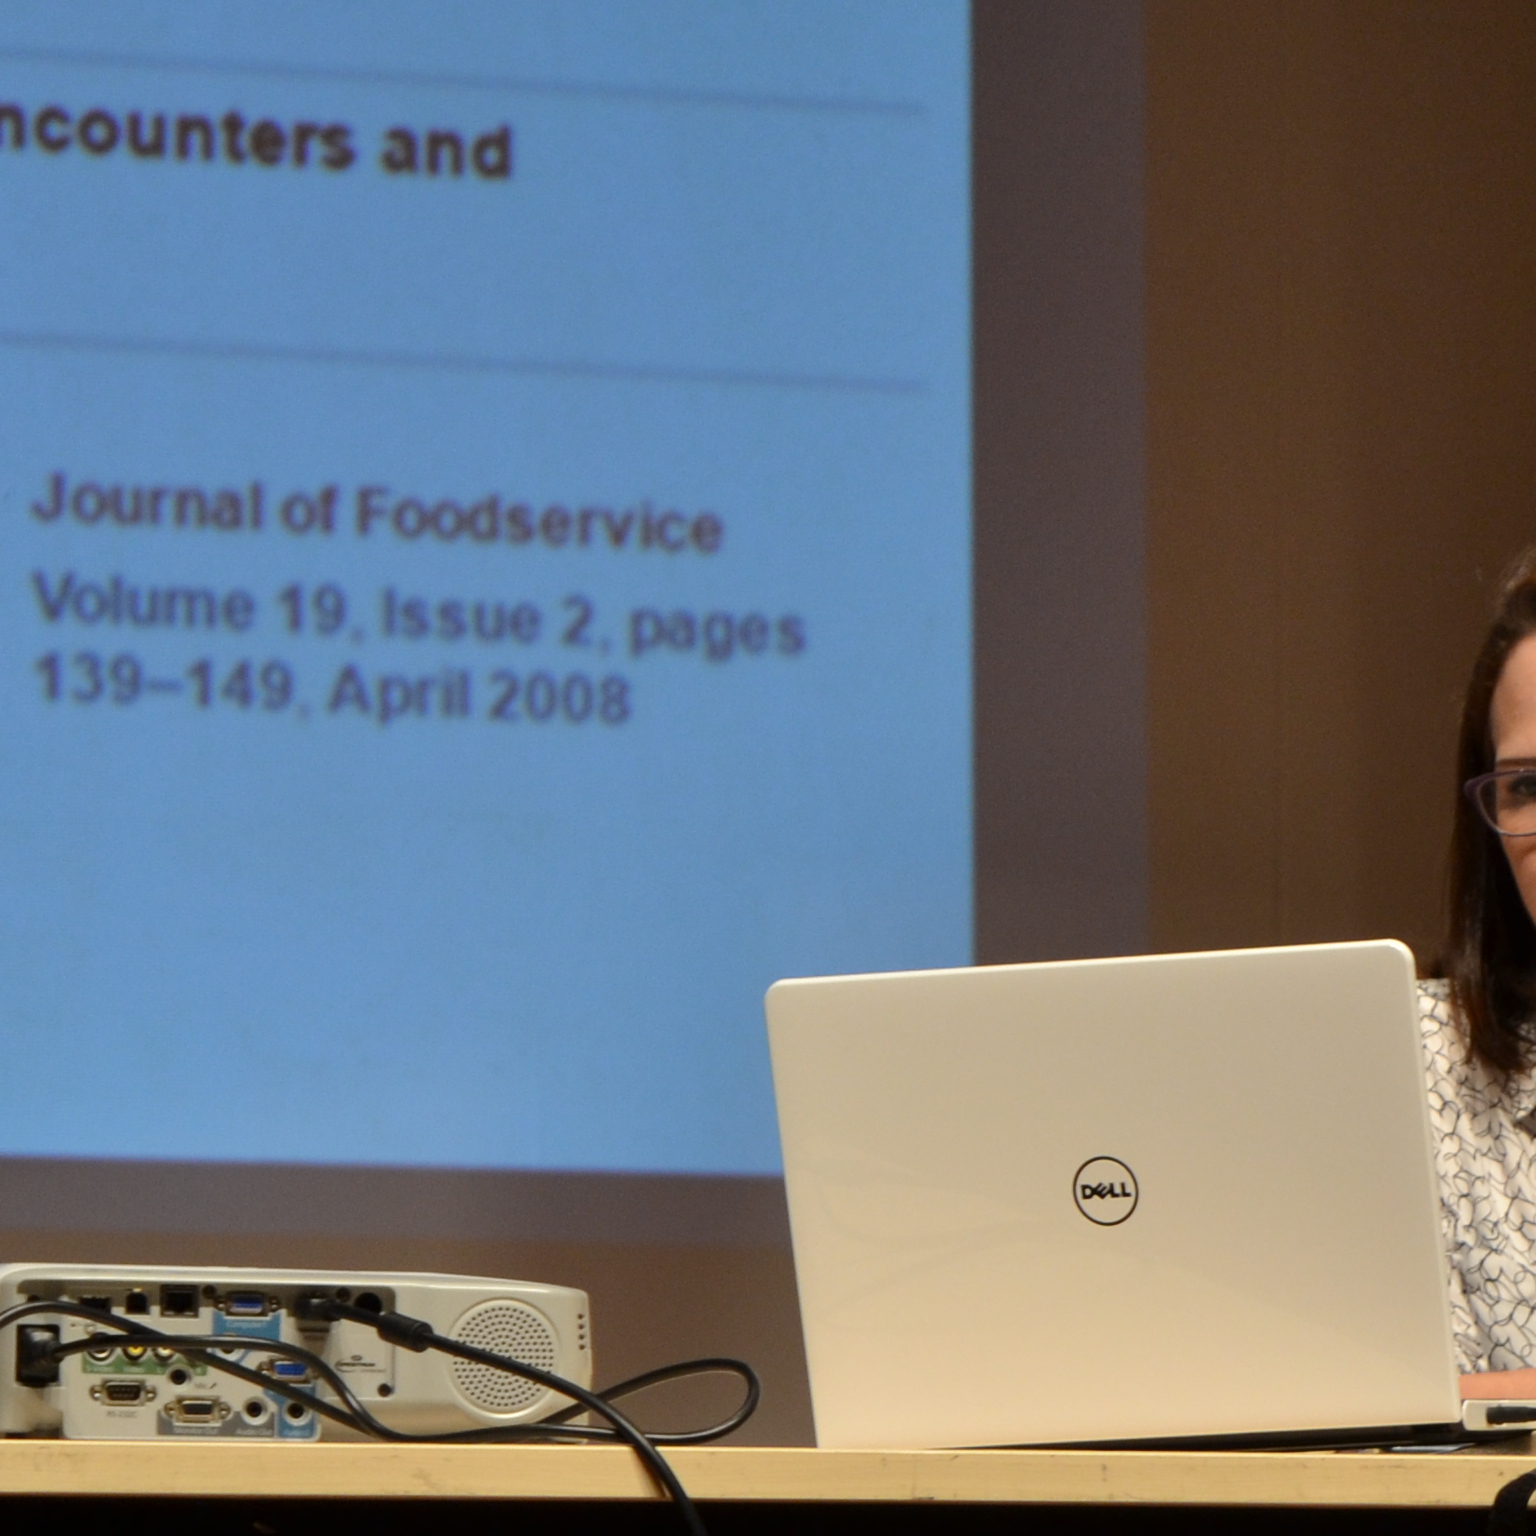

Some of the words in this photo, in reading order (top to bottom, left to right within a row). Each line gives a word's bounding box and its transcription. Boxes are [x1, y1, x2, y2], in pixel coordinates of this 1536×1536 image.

[381, 124, 512, 179] and
[31, 473, 263, 534] Journal
[279, 484, 339, 536] of
[355, 488, 724, 555] Foodservice
[31, 570, 256, 631] Volume
[278, 583, 365, 643] 19,
[382, 588, 542, 645] Issue
[561, 596, 611, 653] 2,
[629, 608, 807, 664] pages
[328, 663, 470, 726] April
[488, 671, 632, 725] 2008
[1081, 1182, 1131, 1200] DELL
